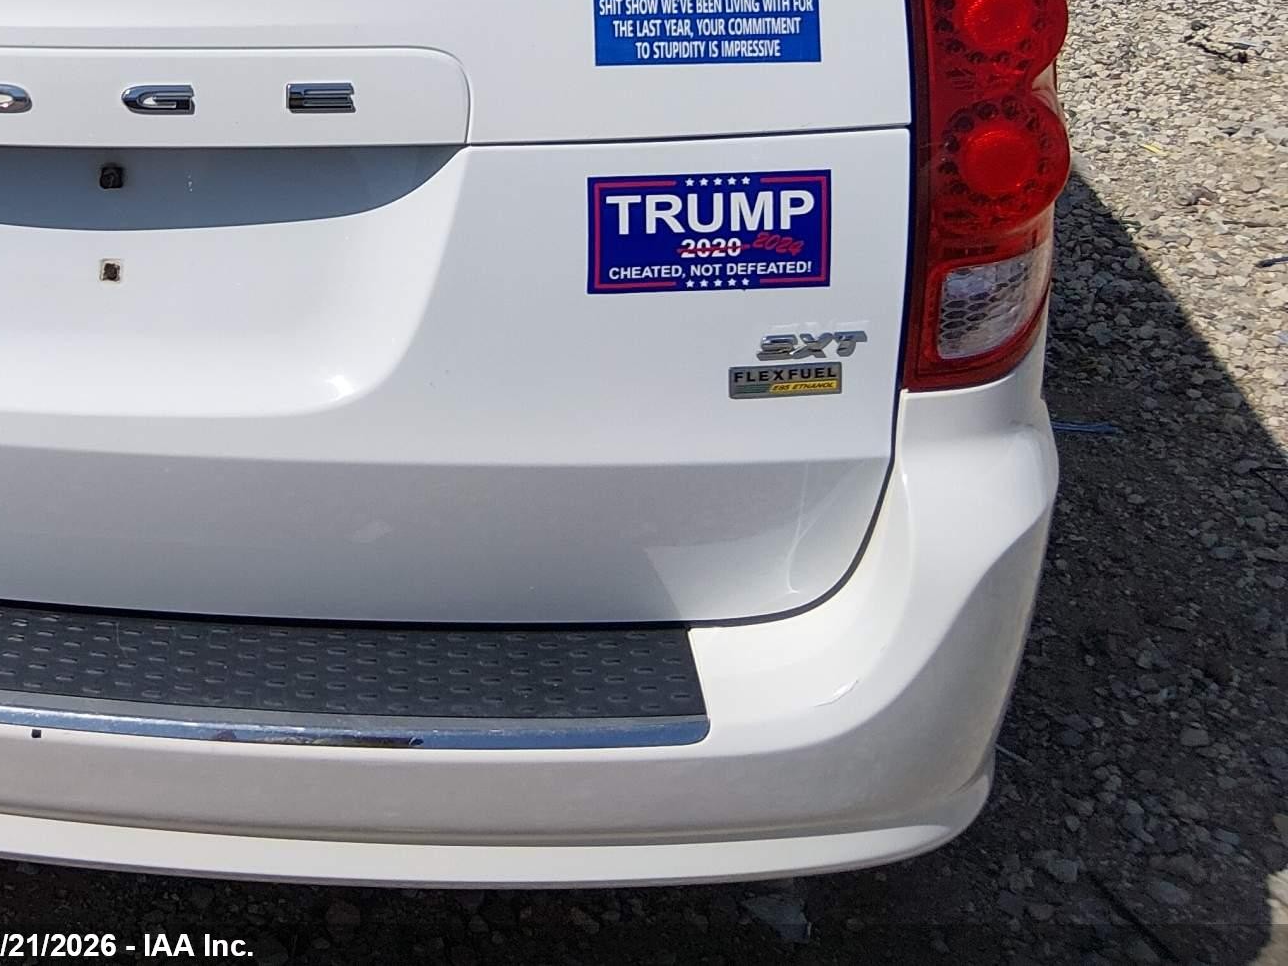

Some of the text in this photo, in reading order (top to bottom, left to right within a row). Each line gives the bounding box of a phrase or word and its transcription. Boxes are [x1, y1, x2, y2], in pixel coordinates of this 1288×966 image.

[599, 0, 623, 15] SHIT
[613, 17, 801, 38] THE LAST YEAR, YOUR COMMITMENT
[636, 39, 781, 59] TO STUPIDITY IS IMPRESSIVE
[606, 190, 815, 235] TRUMP
[680, 232, 805, 258] 2020 2024
[608, 261, 812, 280] CHEATED, NOT DEFEATED!
[756, 330, 868, 361] SXT
[734, 368, 837, 382] FLEXFUEL
